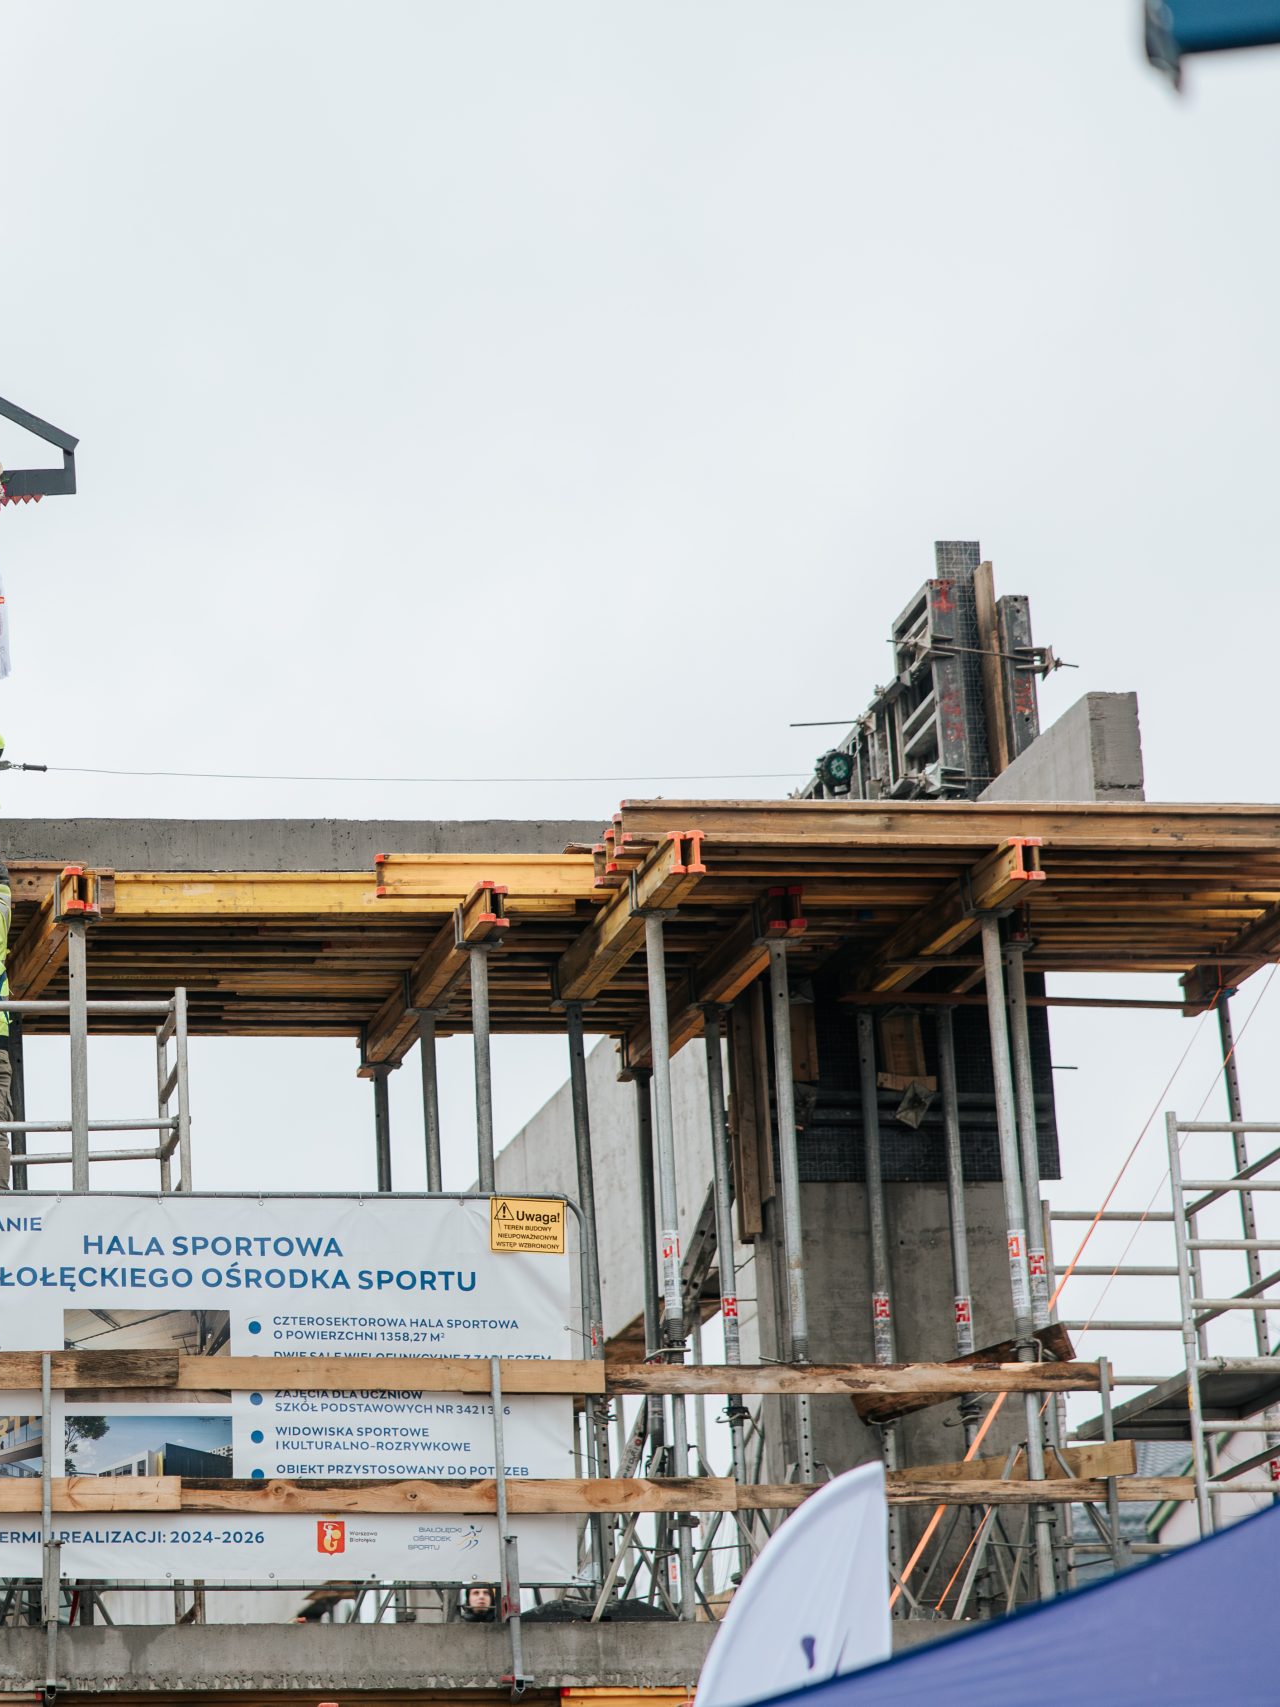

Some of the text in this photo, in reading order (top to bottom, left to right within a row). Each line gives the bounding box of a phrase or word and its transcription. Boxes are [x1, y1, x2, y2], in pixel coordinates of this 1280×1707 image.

[516, 1210, 560, 1225] Uwaga!
[83, 1235, 343, 1258] HALA SPORTOWA
[202, 1261, 351, 1290] OŚRODKA
[358, 1269, 477, 1293] SPORTU
[273, 1315, 519, 1330] CZTEROSEKTOROWA HALA SPORTOWA
[273, 1330, 283, 1340] O
[286, 1330, 378, 1341] POWIERZCHNI
[380, 1331, 428, 1344] 1358,27
[332, 1390, 358, 1399] DLA
[275, 1400, 318, 1412] SZKÓŁ
[320, 1402, 433, 1414] PODSTAWOWYCH
[436, 1404, 454, 1414] NR
[456, 1405, 479, 1415] 342
[487, 1405, 511, 1415] 36
[275, 1426, 429, 1438] WIDOWISKA SPORTOWE
[281, 1440, 471, 1452] KULTURALNO-ROZRYWKOWE
[276, 1464, 529, 1476] OBIEKT PRZYSTOSOWANY DO POTZEB
[60, 1530, 167, 1544] REALIZACJI:
[170, 1530, 265, 1545] 2024-2026
